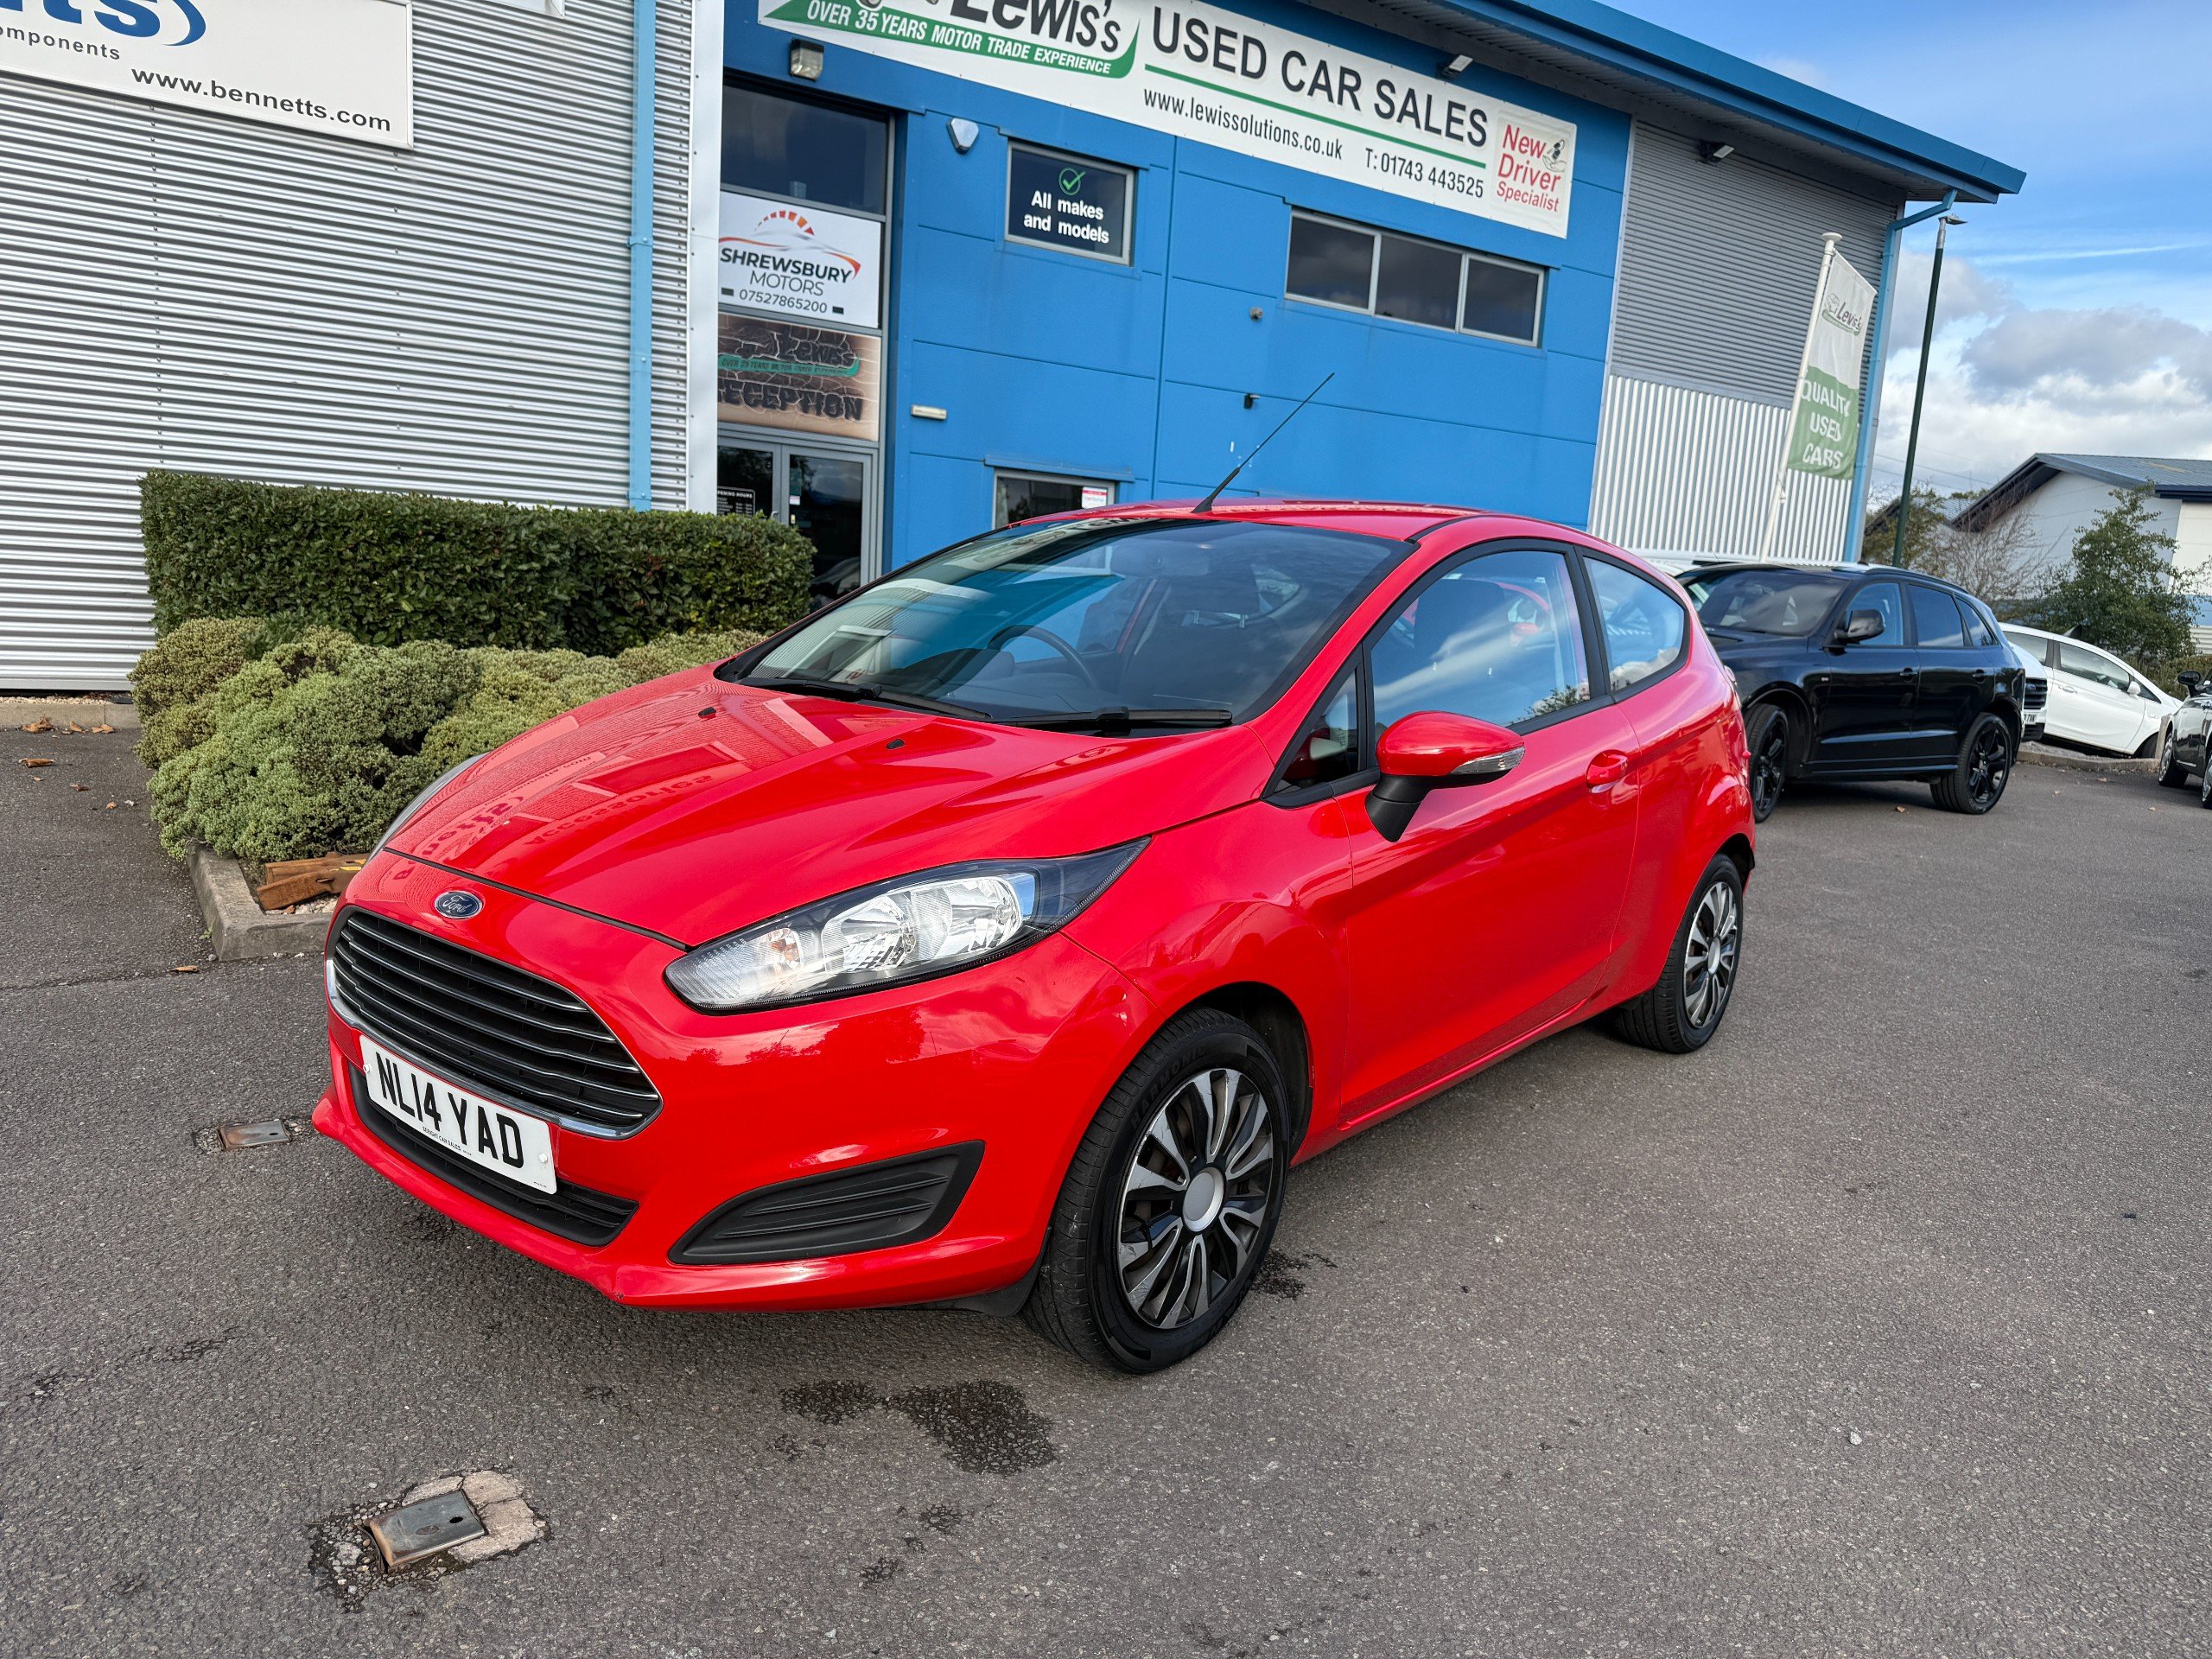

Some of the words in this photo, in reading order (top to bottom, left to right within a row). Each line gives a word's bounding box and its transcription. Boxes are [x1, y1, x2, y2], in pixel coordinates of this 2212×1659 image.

[807, 0, 849, 26] OVER
[855, 9, 878, 31] 35
[881, 13, 925, 40] YEARS
[932, 26, 982, 51] MOTOR
[988, 37, 1029, 60] TRADE
[1034, 48, 1111, 74] EXPERIENCE
[1153, 7, 1267, 79] USED
[1281, 50, 1362, 111] CAR
[1374, 79, 1488, 147] SALES
[131, 67, 391, 132] www.bennetts.com
[1144, 88, 1343, 160] www.lewissolutions.co.uk
[1380, 153, 1423, 182] 01743
[1428, 166, 1484, 199] 443525
[1503, 124, 1546, 158] New
[1497, 153, 1561, 192] Driver
[1031, 190, 1052, 209] All
[1058, 199, 1104, 220] makes
[1497, 181, 1559, 212] Specialist
[1024, 213, 1051, 232] and
[1058, 220, 1109, 244] models
[720, 248, 853, 283] SHREWSBURY
[750, 270, 824, 296] MOTORS
[739, 289, 827, 314] 07527865200
[1809, 411, 1841, 442] USED
[1802, 442, 1843, 469] CARS
[375, 1052, 442, 1132] NL14
[448, 1093, 524, 1169] YAD
